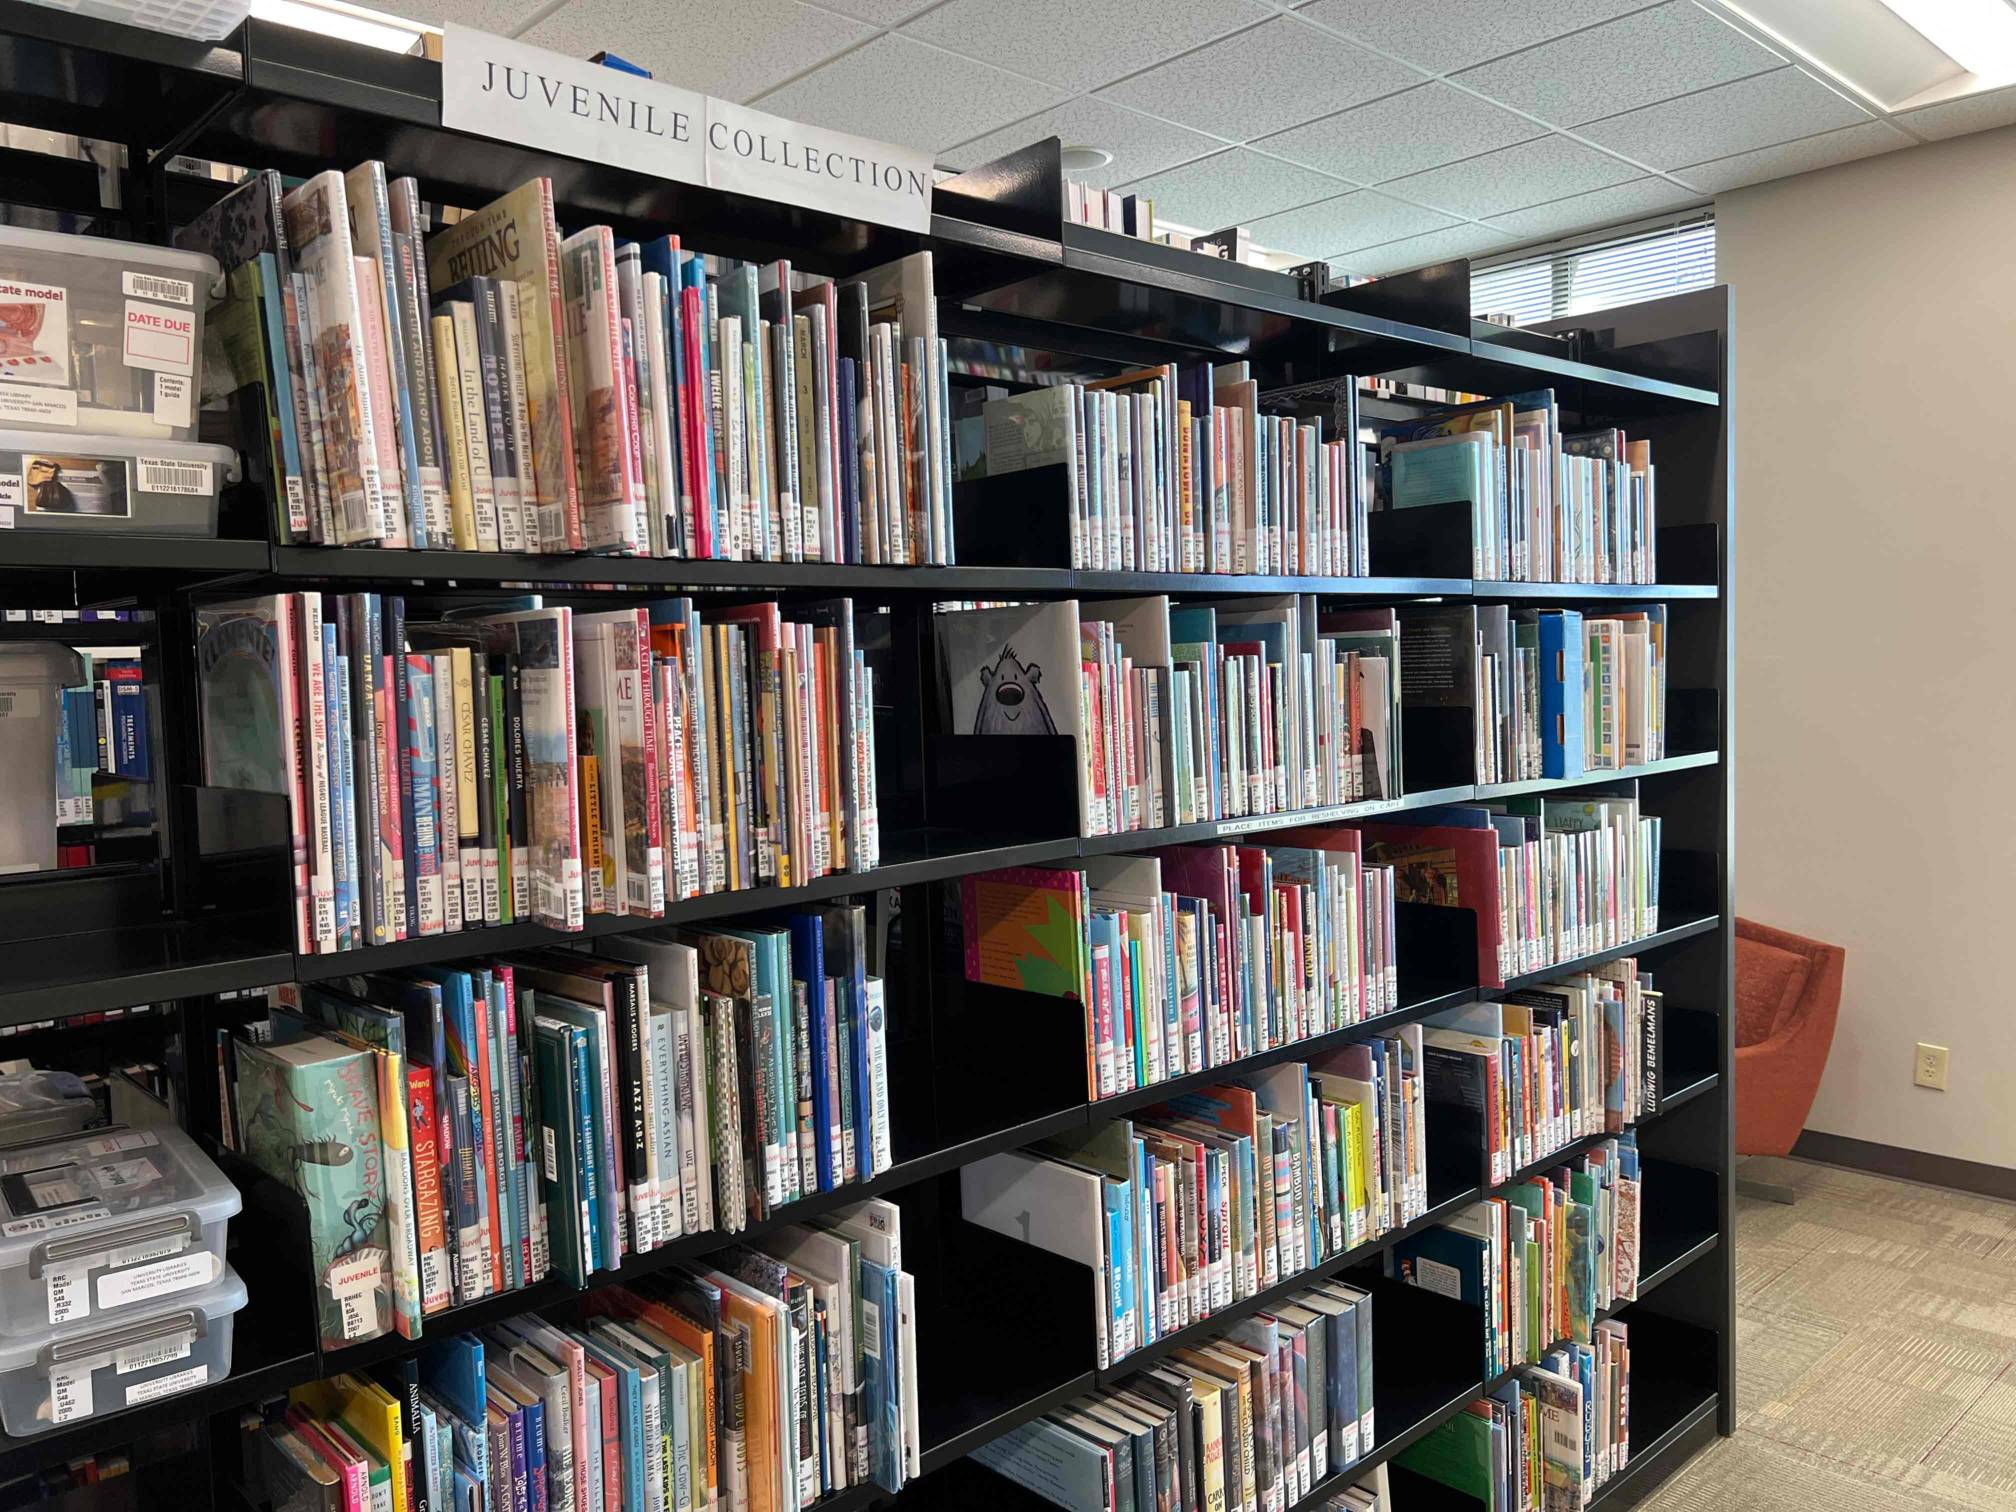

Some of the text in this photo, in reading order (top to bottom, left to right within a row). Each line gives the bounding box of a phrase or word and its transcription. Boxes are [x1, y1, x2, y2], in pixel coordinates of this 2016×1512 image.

[482, 60, 927, 198] JUVENILE COLLECTION
[25, 288, 63, 301] model
[128, 312, 191, 333] DATE DUE
[166, 384, 182, 392] model
[166, 391, 180, 399] guide
[140, 458, 207, 470] Texas State University
[1222, 801, 1400, 833] PLACE ITEMS FOR RESHELVING ON CART
[1645, 1000, 1657, 1111] LUDWIG BEMELMANS
[358, 1133, 379, 1201] STORY
[53, 1275, 66, 1283] RRC
[338, 1266, 378, 1286] JUVENILE
[53, 1280, 72, 1289] Model
[54, 1308, 69, 1316] 2005
[57, 1379, 76, 1388] Model
